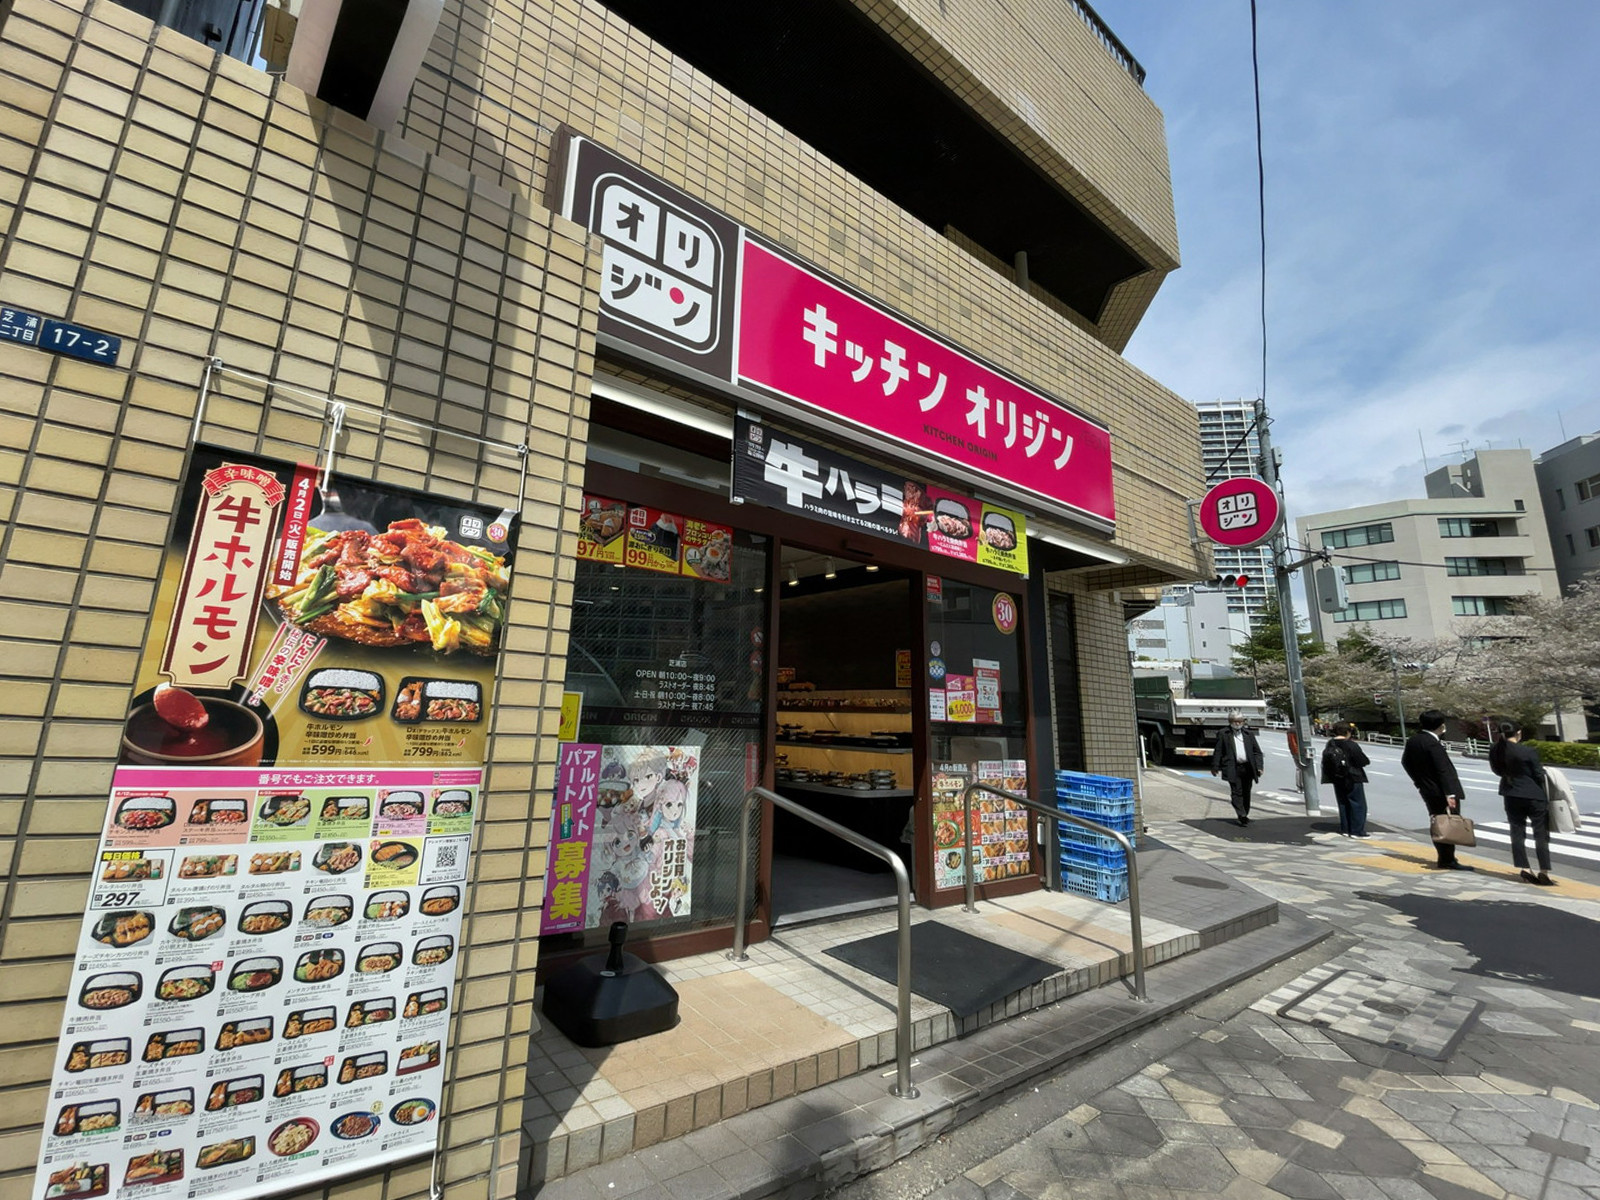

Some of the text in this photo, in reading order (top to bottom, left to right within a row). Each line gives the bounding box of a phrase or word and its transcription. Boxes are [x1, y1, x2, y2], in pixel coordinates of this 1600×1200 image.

[2, 311, 38, 328] 芝浦
[54, 328, 110, 356] 17-2
[803, 303, 1074, 470] キッチン オリジン
[923, 424, 998, 463] KITCHEN ORIGIN
[224, 468, 271, 487] 辛味噌
[764, 439, 903, 516] 牛ハラミ
[189, 494, 262, 676] 牛ホルモン
[636, 669, 657, 679] OPEN
[258, 773, 379, 785] 番号でもご注文できます。
[565, 749, 583, 802] パート
[577, 750, 597, 837] アルバイト
[549, 841, 588, 920] 募集
[662, 840, 674, 891] オリジン
[674, 839, 686, 877] お花見
